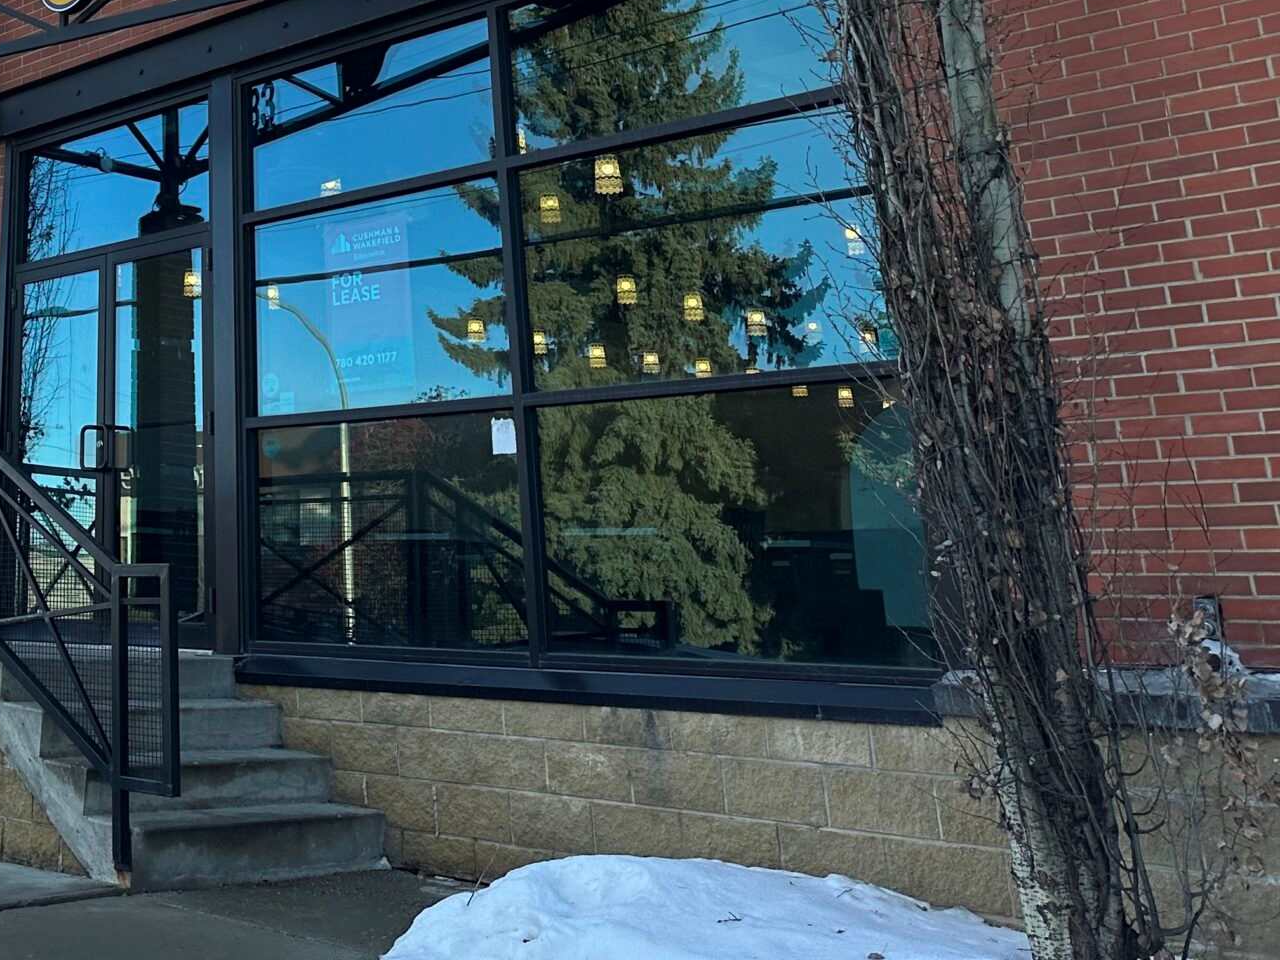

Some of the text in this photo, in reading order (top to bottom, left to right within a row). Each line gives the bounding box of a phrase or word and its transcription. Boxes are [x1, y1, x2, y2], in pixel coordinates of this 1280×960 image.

[331, 271, 362, 289] FOR
[332, 284, 381, 306] LEASE
[355, 354, 375, 366] 420
